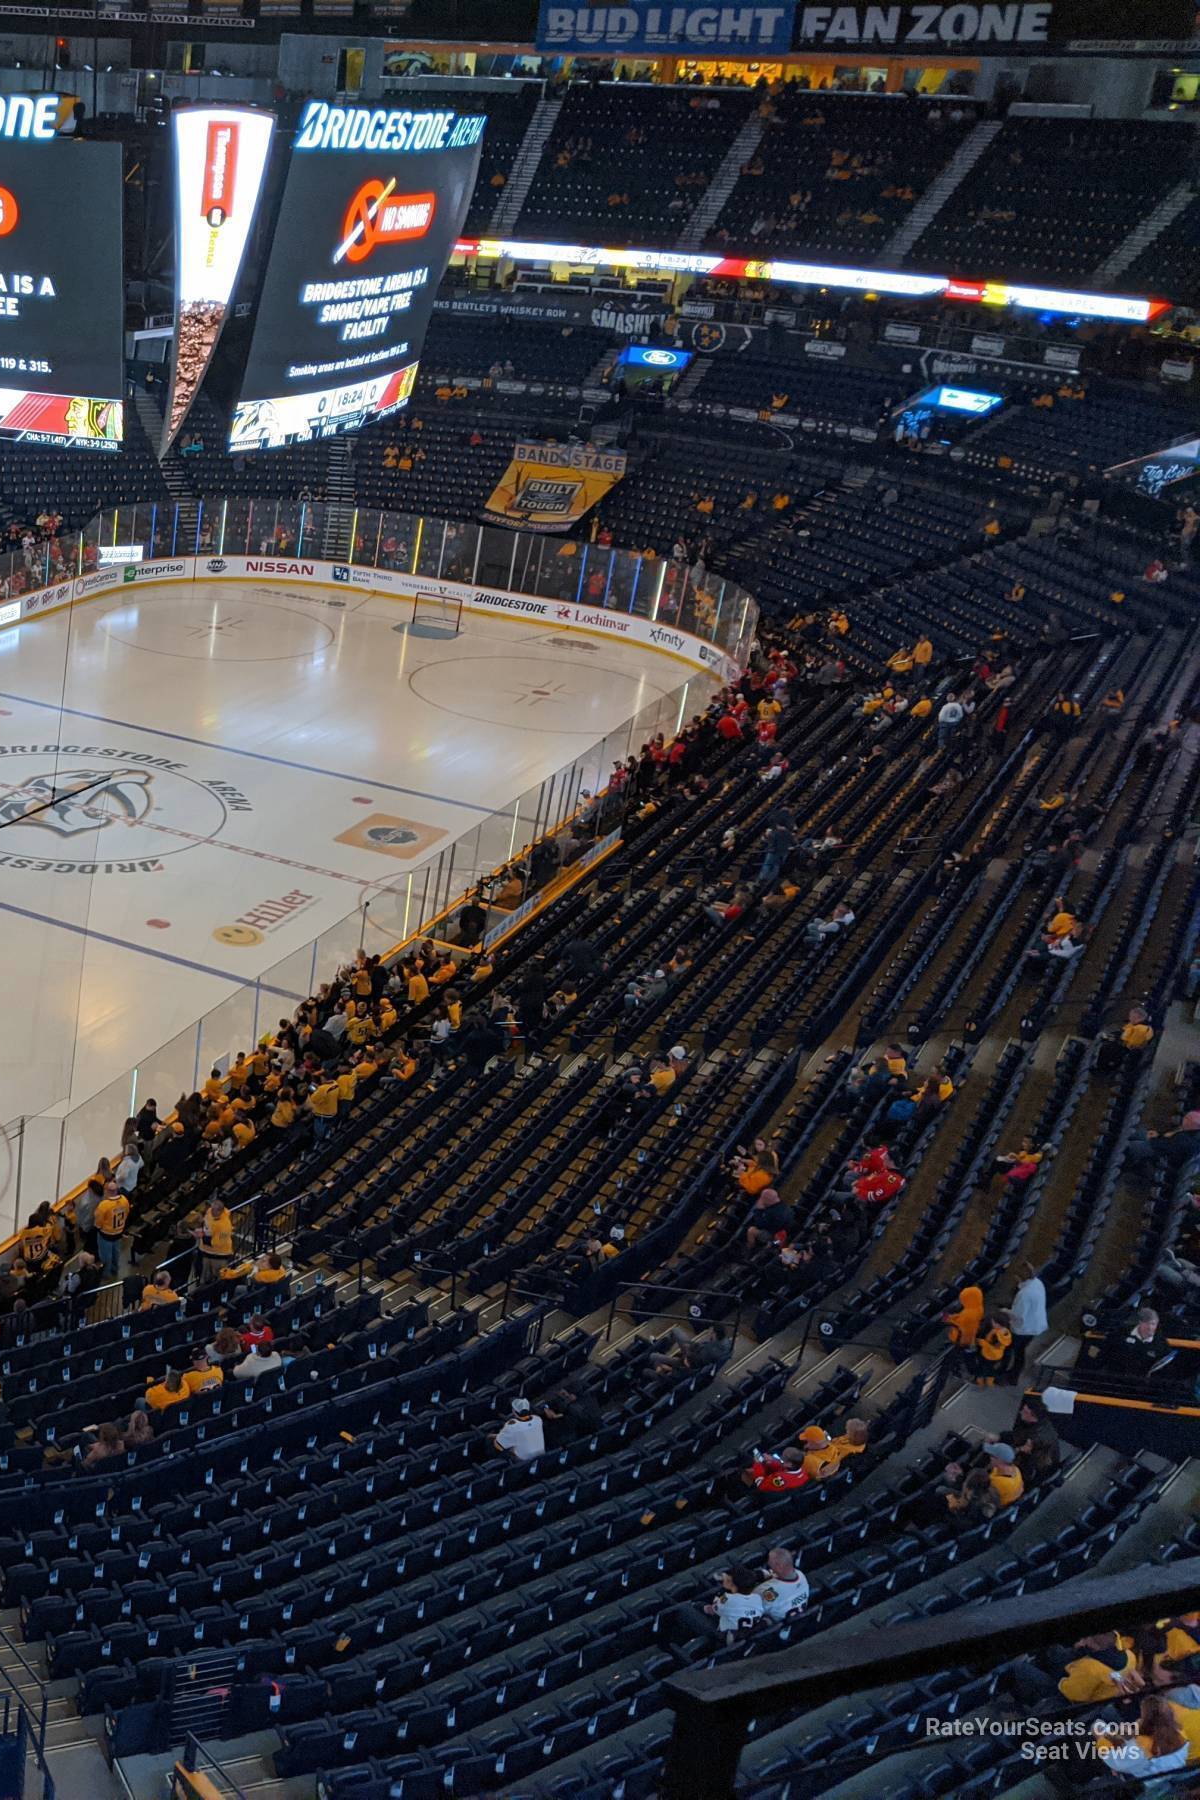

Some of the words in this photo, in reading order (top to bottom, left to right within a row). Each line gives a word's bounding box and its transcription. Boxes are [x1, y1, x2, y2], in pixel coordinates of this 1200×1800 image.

[546, 8, 639, 44] BUD
[645, 8, 785, 44] LIGHT
[800, 6, 900, 44] FAN
[906, 3, 1053, 43] ZONE
[296, 103, 455, 150] BRIDGESTONE
[447, 115, 487, 148] ARENA
[662, 255, 687, 265] 18:24
[13, 274, 34, 295] IS
[39, 276, 56, 297] A
[303, 277, 384, 303] BRIDGESTONE
[383, 272, 412, 292] ARENA
[412, 270, 422, 287] IS
[420, 267, 429, 284] A
[320, 296, 389, 323] SMOKE/VAPE
[391, 290, 413, 310] FREE
[452, 300, 498, 313] BENTLEY'S
[500, 304, 545, 318] WHISKEY
[546, 307, 568, 318] ROW
[342, 315, 390, 341] FACILITY
[0, 357, 16, 370] 119
[18, 359, 27, 371] &
[29, 359, 52, 374] 315.
[289, 364, 317, 377] Smoking
[318, 361, 335, 373] areas
[338, 388, 363, 407] 18:24
[370, 384, 377, 400] 0
[317, 396, 327, 413] 0
[322, 425, 337, 438] NYK
[517, 447, 559, 465] BAND
[573, 453, 625, 472] STAGE
[528, 481, 576, 495] BUILT
[519, 500, 565, 511] TOUGH
[127, 562, 184, 580] enterprise
[246, 560, 314, 576] NISSAN
[352, 569, 371, 578] FIFTH
[373, 572, 393, 582] THIRD
[352, 576, 370, 584] BANK
[474, 591, 549, 615] BRIDGESTONE
[575, 609, 630, 633] Lochinvar
[649, 627, 686, 651] xfinity
[201, 778, 254, 813] ARENA
[236, 888, 314, 930] Hiller
